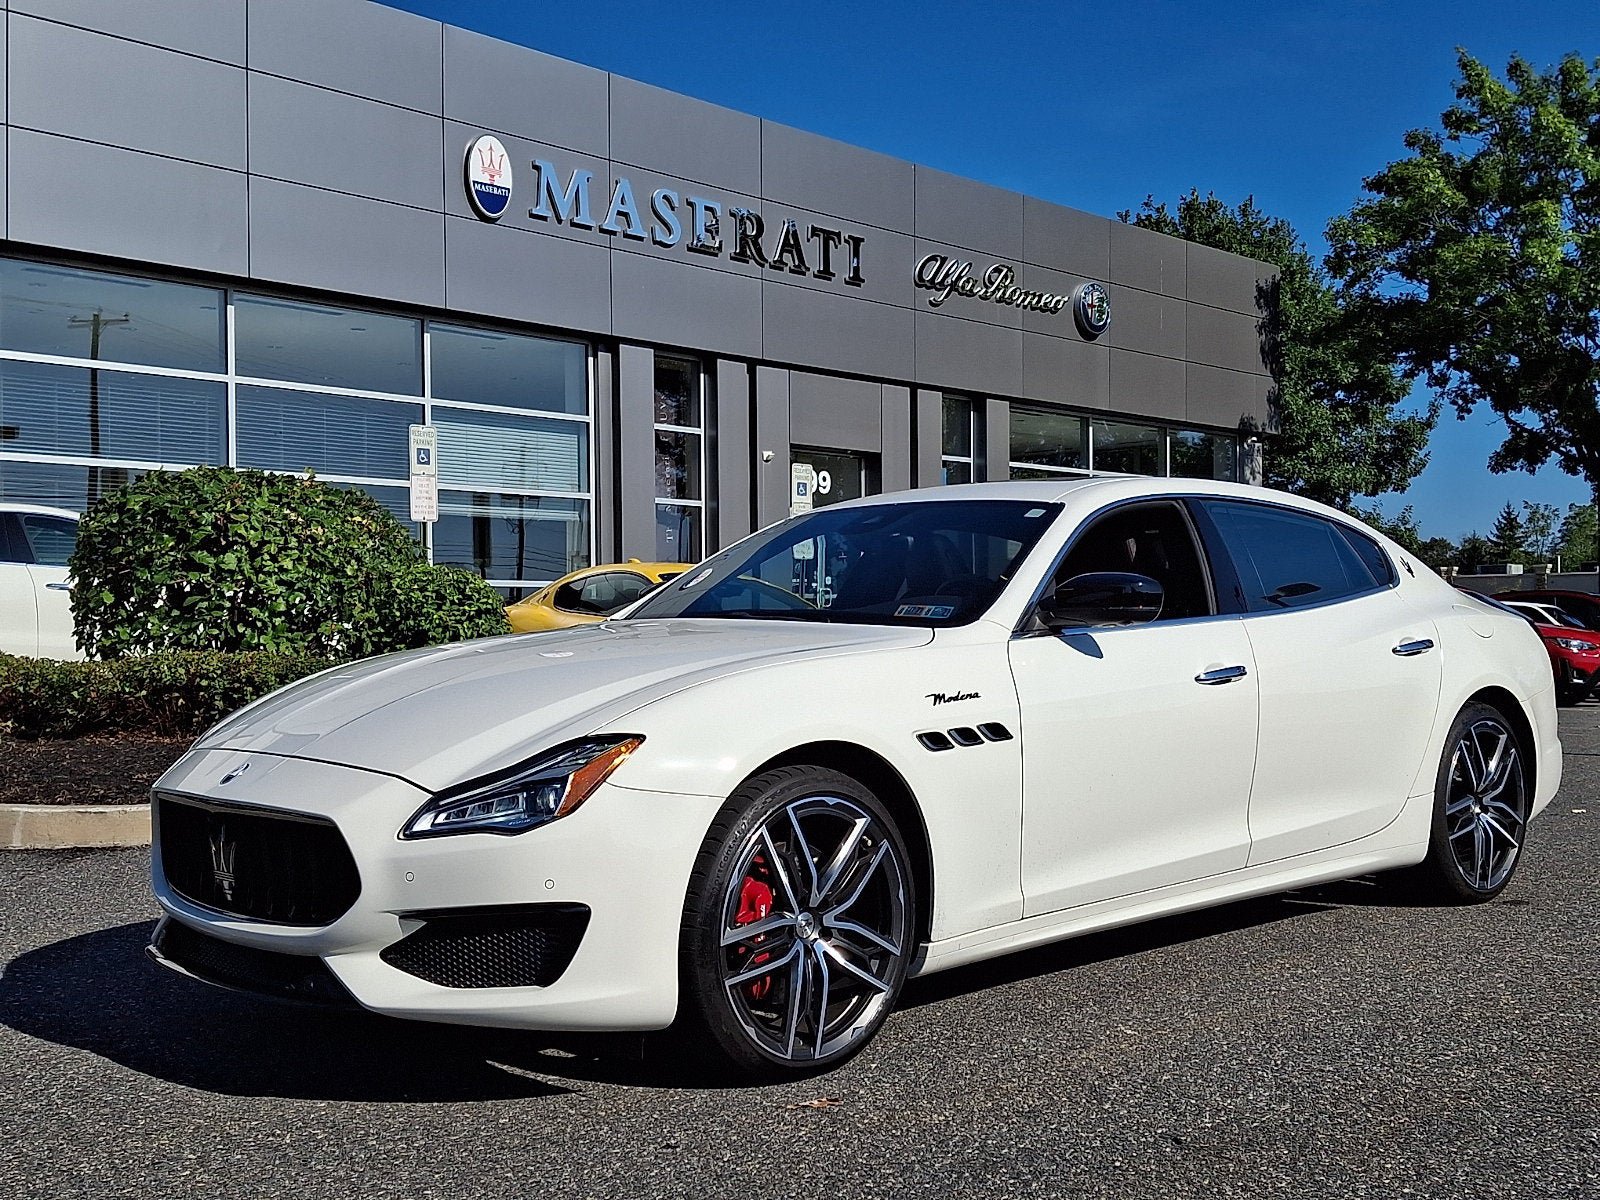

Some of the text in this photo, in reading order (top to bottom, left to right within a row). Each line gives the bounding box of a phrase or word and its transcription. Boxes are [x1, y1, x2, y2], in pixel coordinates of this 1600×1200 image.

[474, 183, 509, 197] MASERATI
[528, 159, 866, 287] MASERATI
[914, 254, 1070, 315] Alfa Romeo
[925, 691, 981, 706] Modena
